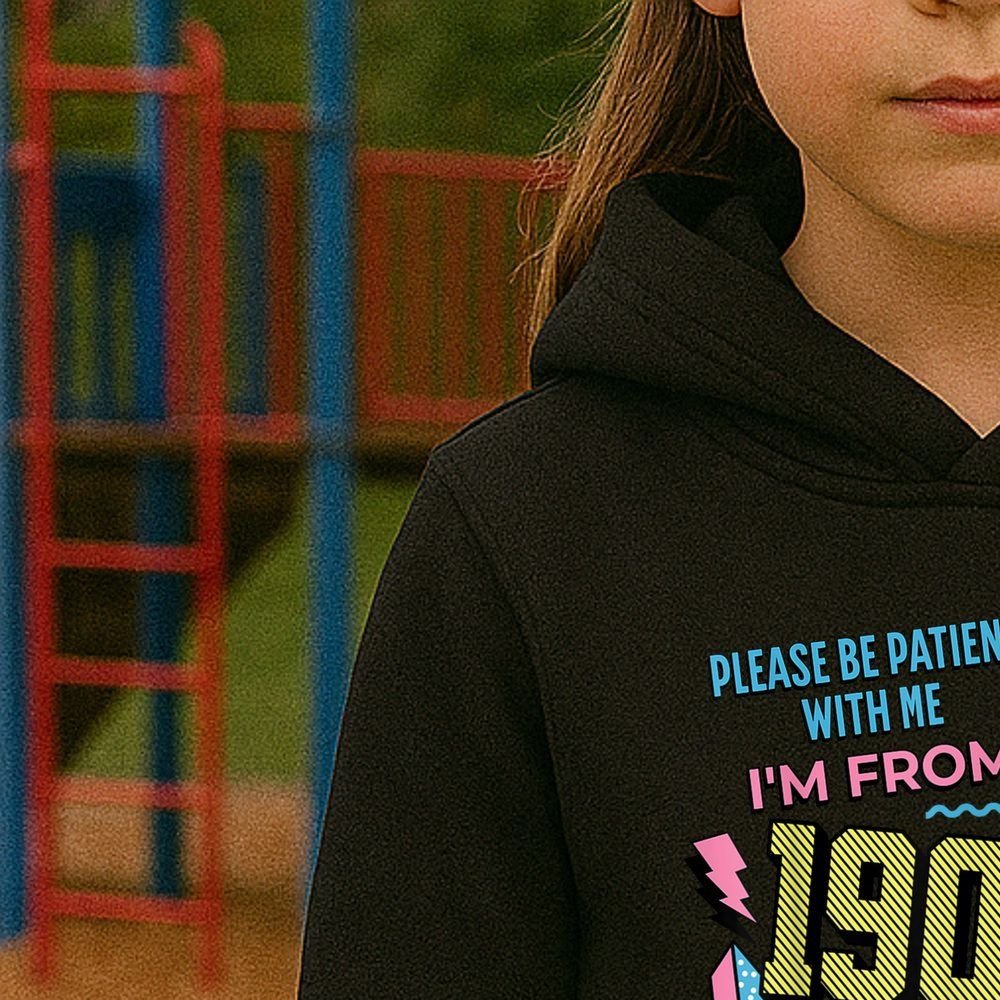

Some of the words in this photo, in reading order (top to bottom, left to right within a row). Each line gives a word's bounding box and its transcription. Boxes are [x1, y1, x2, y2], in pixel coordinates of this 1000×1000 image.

[709, 640, 832, 699] PLEASE
[837, 635, 880, 681] BE
[801, 690, 891, 741] WITH
[899, 683, 945, 728] ME
[749, 761, 828, 809] I'M
